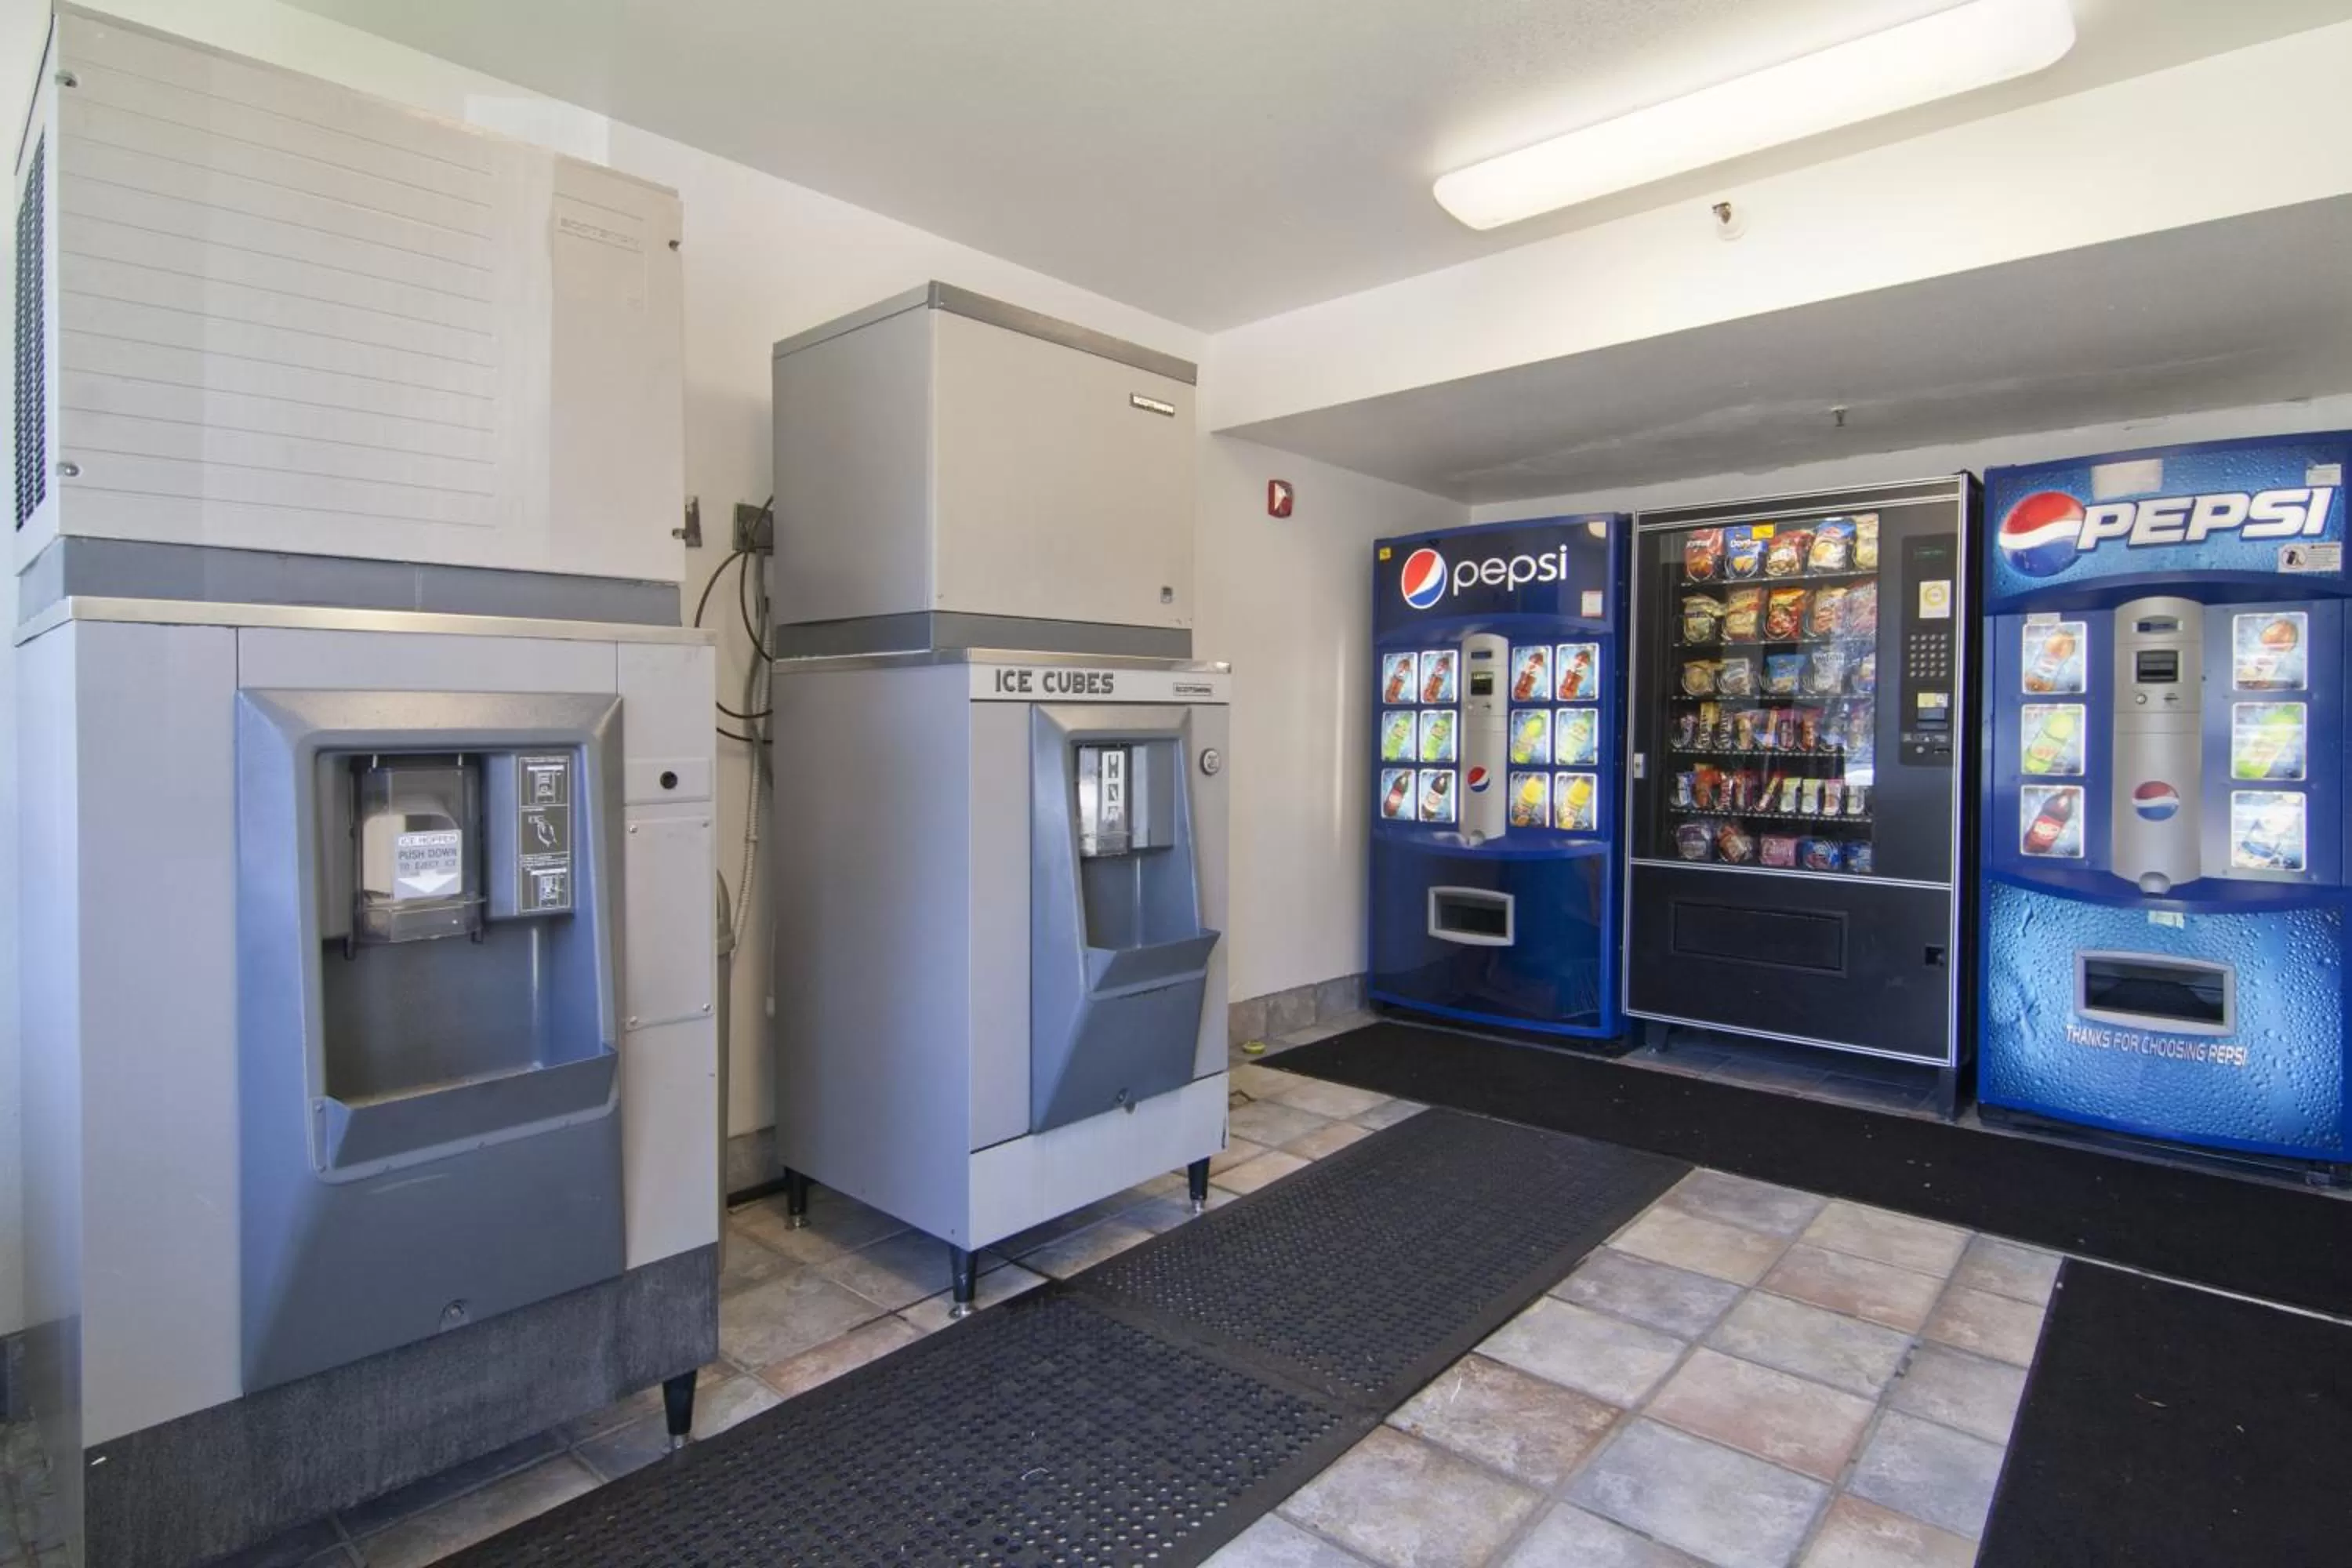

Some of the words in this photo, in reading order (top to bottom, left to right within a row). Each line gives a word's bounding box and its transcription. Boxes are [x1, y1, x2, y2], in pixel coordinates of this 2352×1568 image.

[2076, 488, 2333, 550] PEPSI
[1453, 544, 1568, 596] pepsi
[995, 669, 1033, 693] ICE
[1043, 672, 1114, 695] CUBES
[397, 850, 425, 860] PUSH
[427, 848, 457, 858] DOWN
[2066, 1025, 2111, 1048] THANKS
[2113, 1032, 2139, 1051] FOR
[2141, 1036, 2206, 1062] CHOOSING
[2207, 1044, 2248, 1065] PEPSI
